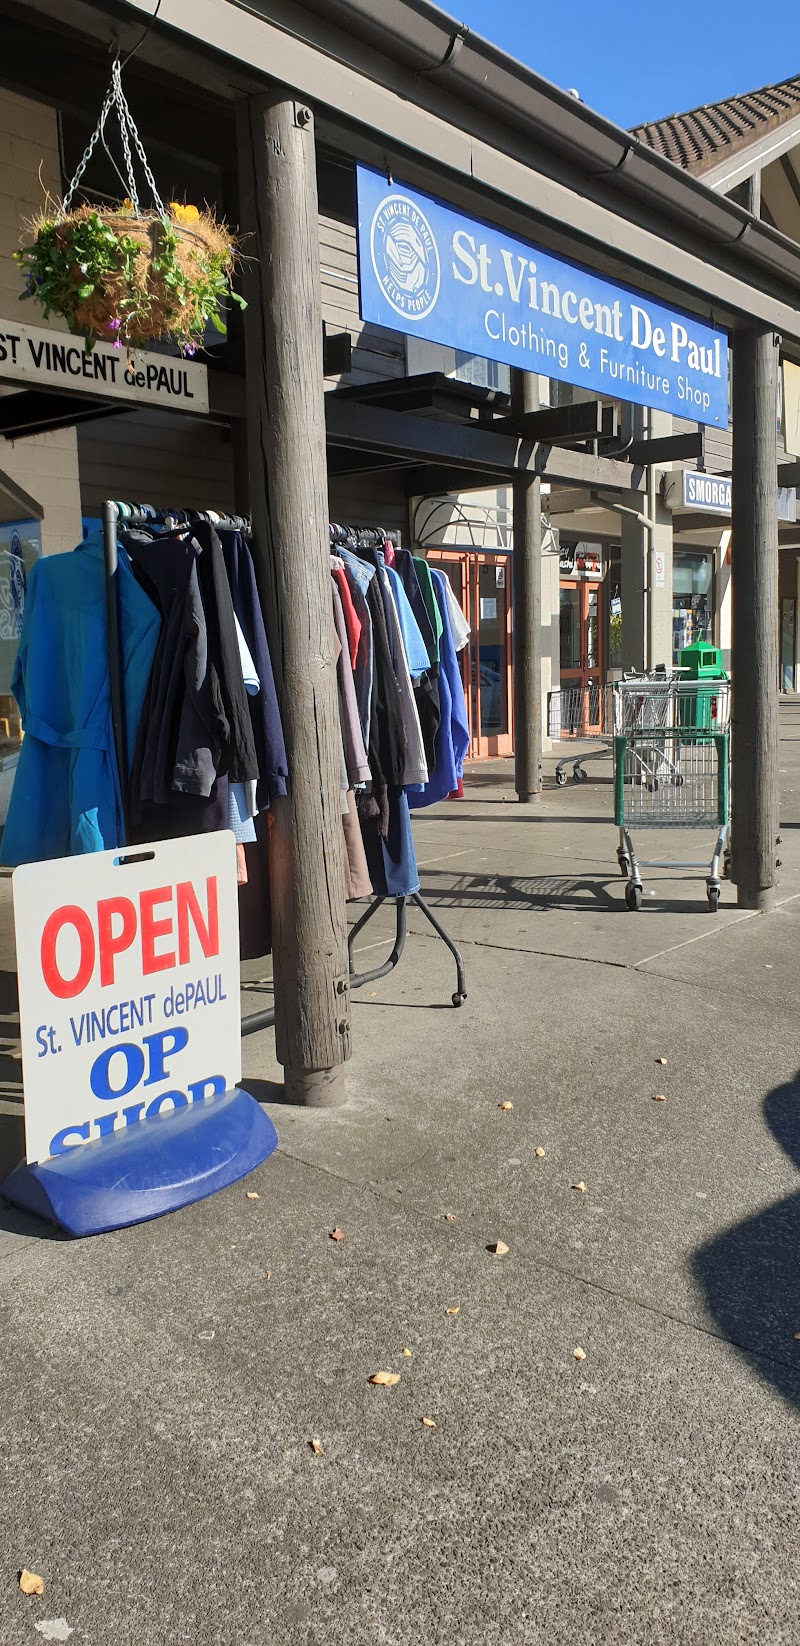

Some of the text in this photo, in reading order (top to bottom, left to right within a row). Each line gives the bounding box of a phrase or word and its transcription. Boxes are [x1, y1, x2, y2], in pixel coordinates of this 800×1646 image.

[382, 203, 411, 221] VINCENT
[411, 211, 420, 227] DE
[420, 224, 434, 253] PAUL
[382, 274, 432, 312] HELPS PEOPLE
[27, 339, 120, 382] VINCENT
[123, 359, 194, 398] dePAUL
[484, 309, 711, 413] Clothing & Furniture Shop
[688, 477, 731, 506] SMORGA
[40, 875, 220, 999] OPEN
[35, 973, 227, 1058] St. VINCENT dePAUL
[89, 1026, 189, 1101] OP
